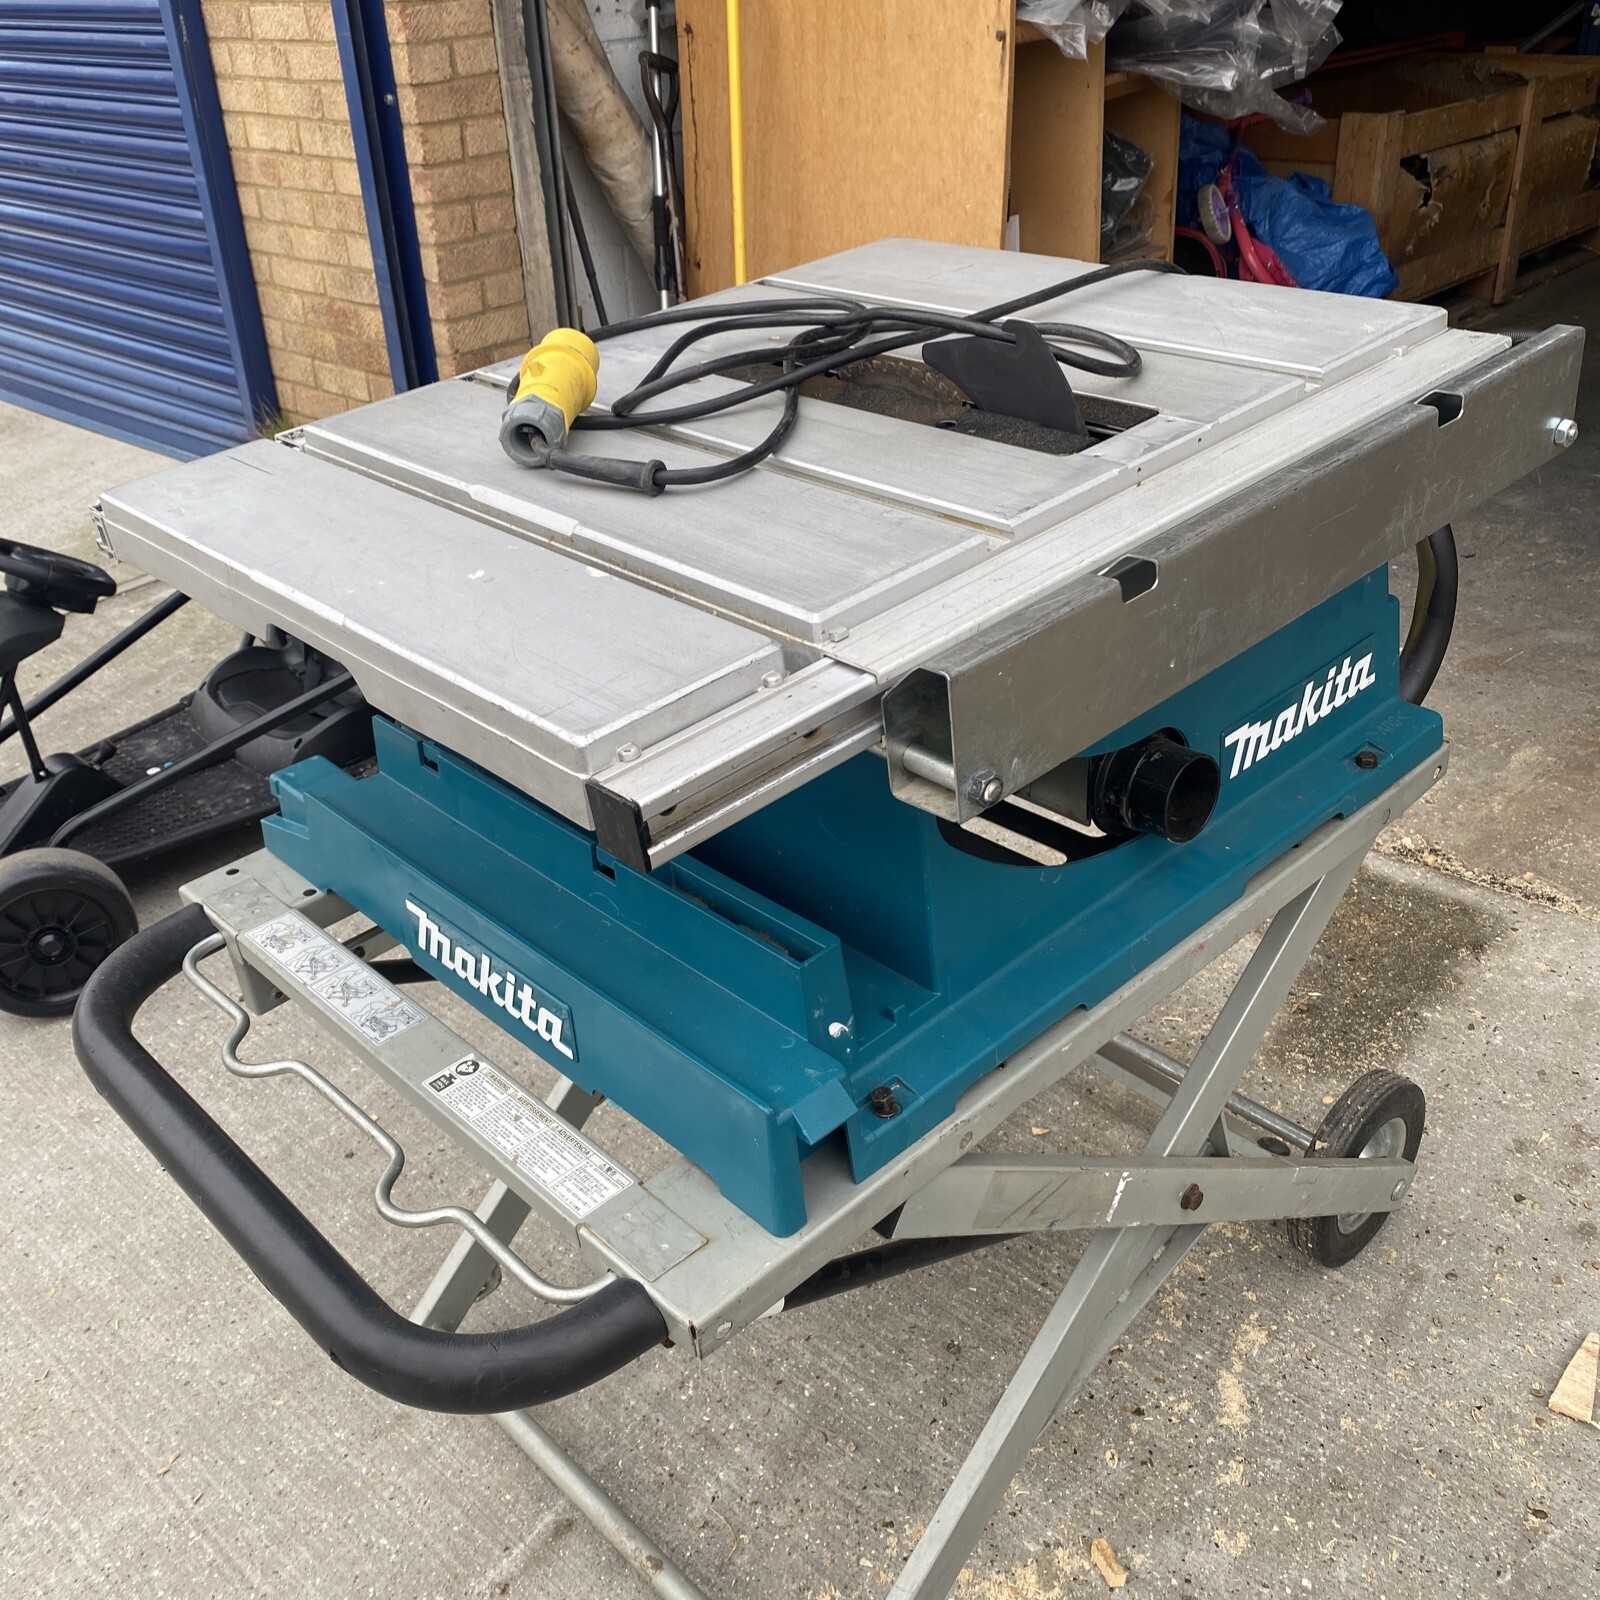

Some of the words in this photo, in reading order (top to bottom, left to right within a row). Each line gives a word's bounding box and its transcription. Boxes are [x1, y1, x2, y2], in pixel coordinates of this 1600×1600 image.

[489, 1072, 511, 1092] WARNING
[517, 1094, 552, 1126] AVERTISSEMENT
[557, 1128, 591, 1156] ADVERTENCIA
